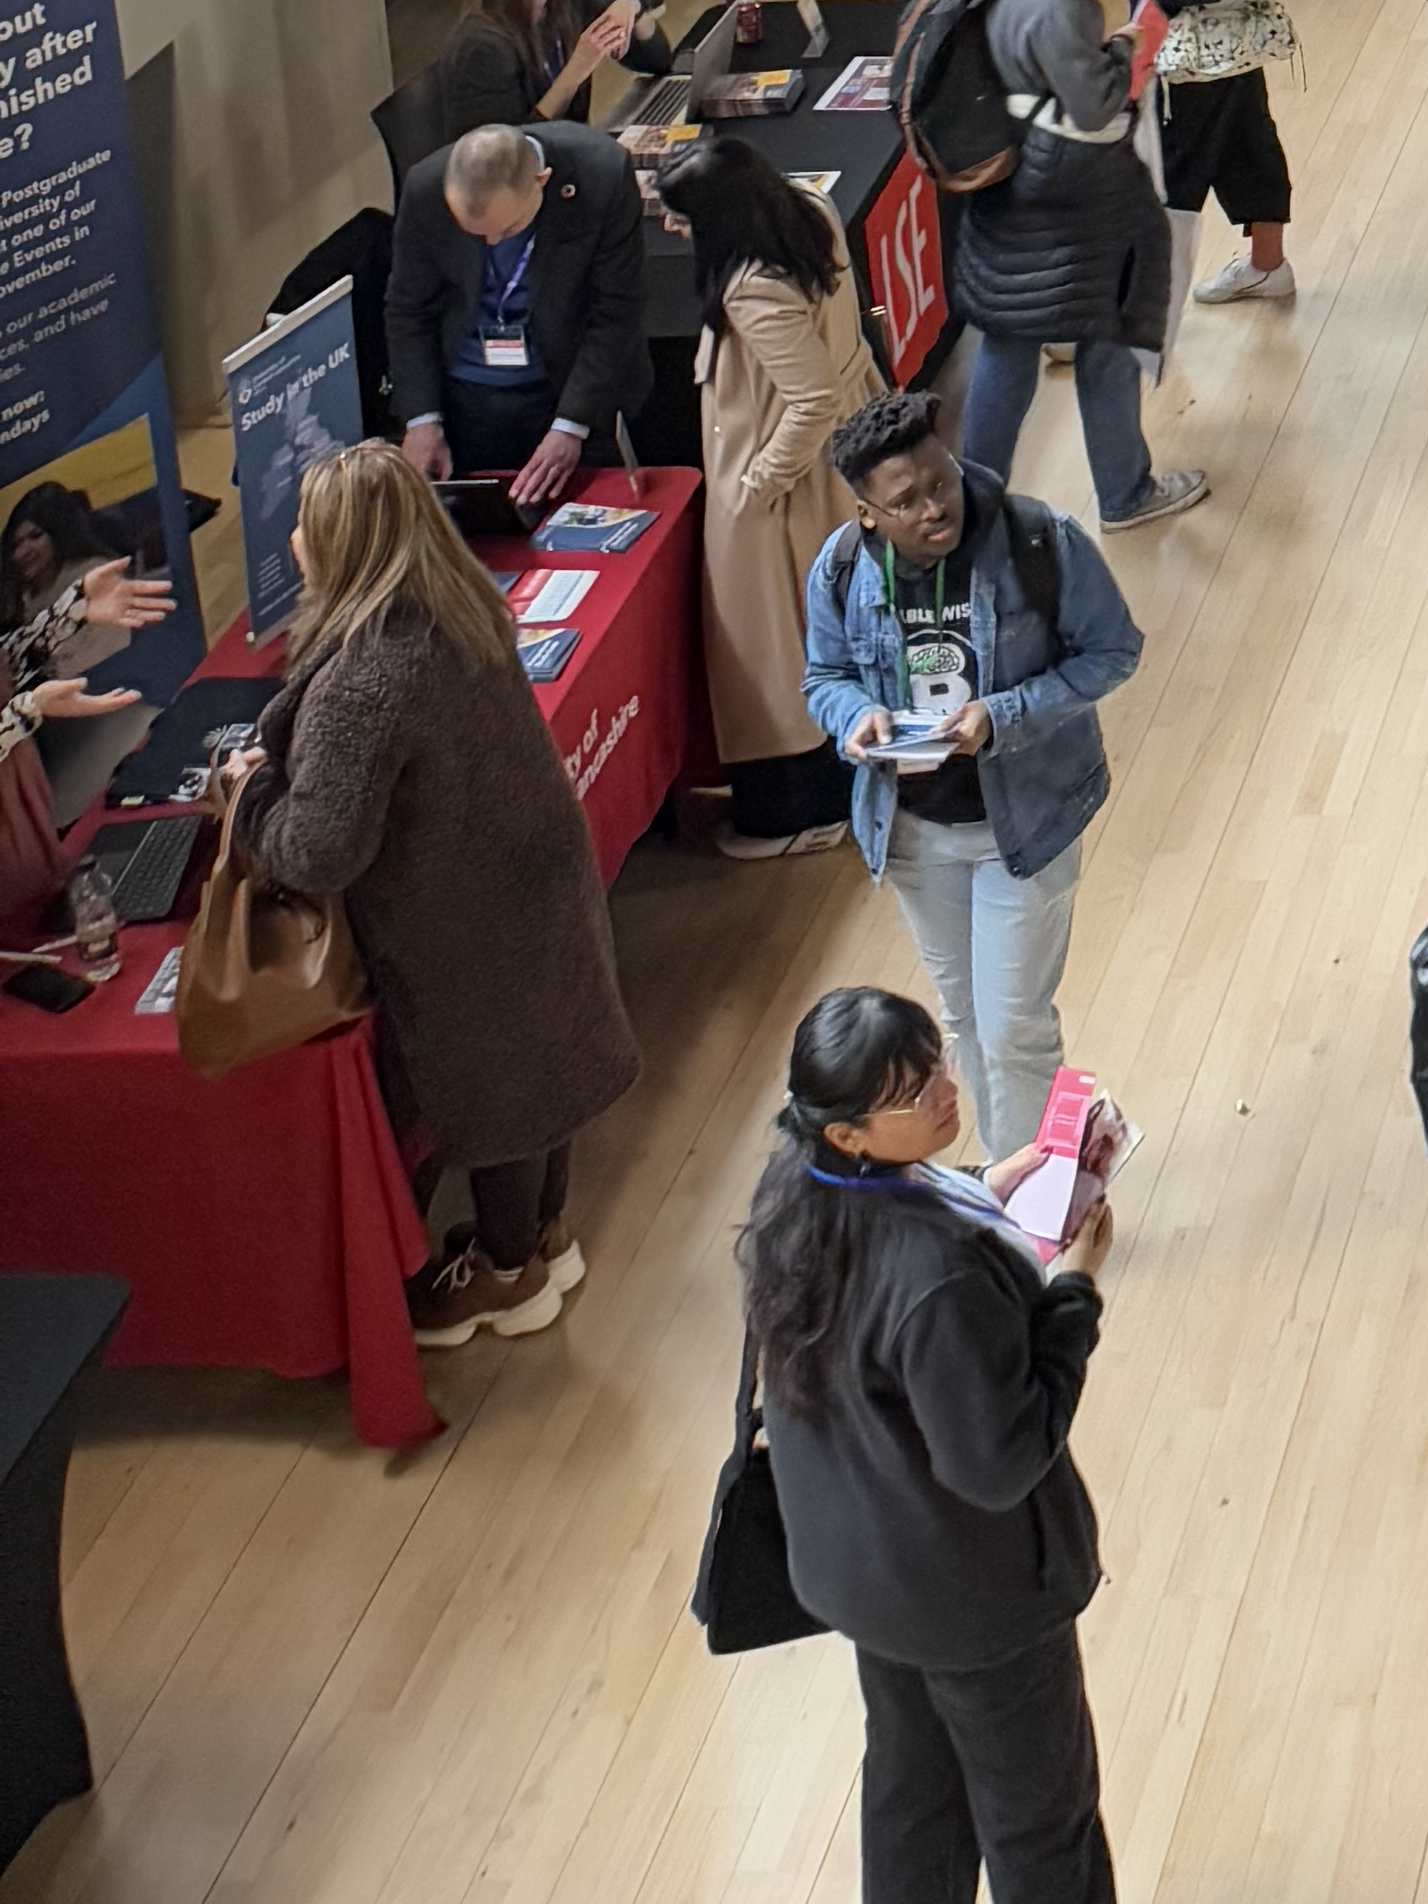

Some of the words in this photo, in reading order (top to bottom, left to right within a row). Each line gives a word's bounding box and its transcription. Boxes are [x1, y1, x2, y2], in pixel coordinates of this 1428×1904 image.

[25, 21, 97, 71] after
[1, 148, 111, 208] Postgraduate
[64, 180, 80, 202] of
[11, 224, 44, 247] one
[49, 209, 66, 230] of
[70, 199, 96, 220] our
[14, 235, 70, 268] Events
[74, 225, 90, 240] in
[880, 175, 935, 369] LSE
[6, 313, 34, 331] our
[37, 273, 117, 318] academic
[34, 316, 65, 342] and
[69, 298, 109, 325] have
[2, 390, 46, 420] now:
[240, 393, 284, 433] Study
[302, 364, 327, 388] the
[328, 343, 350, 370] UK
[583, 708, 598, 754] of
